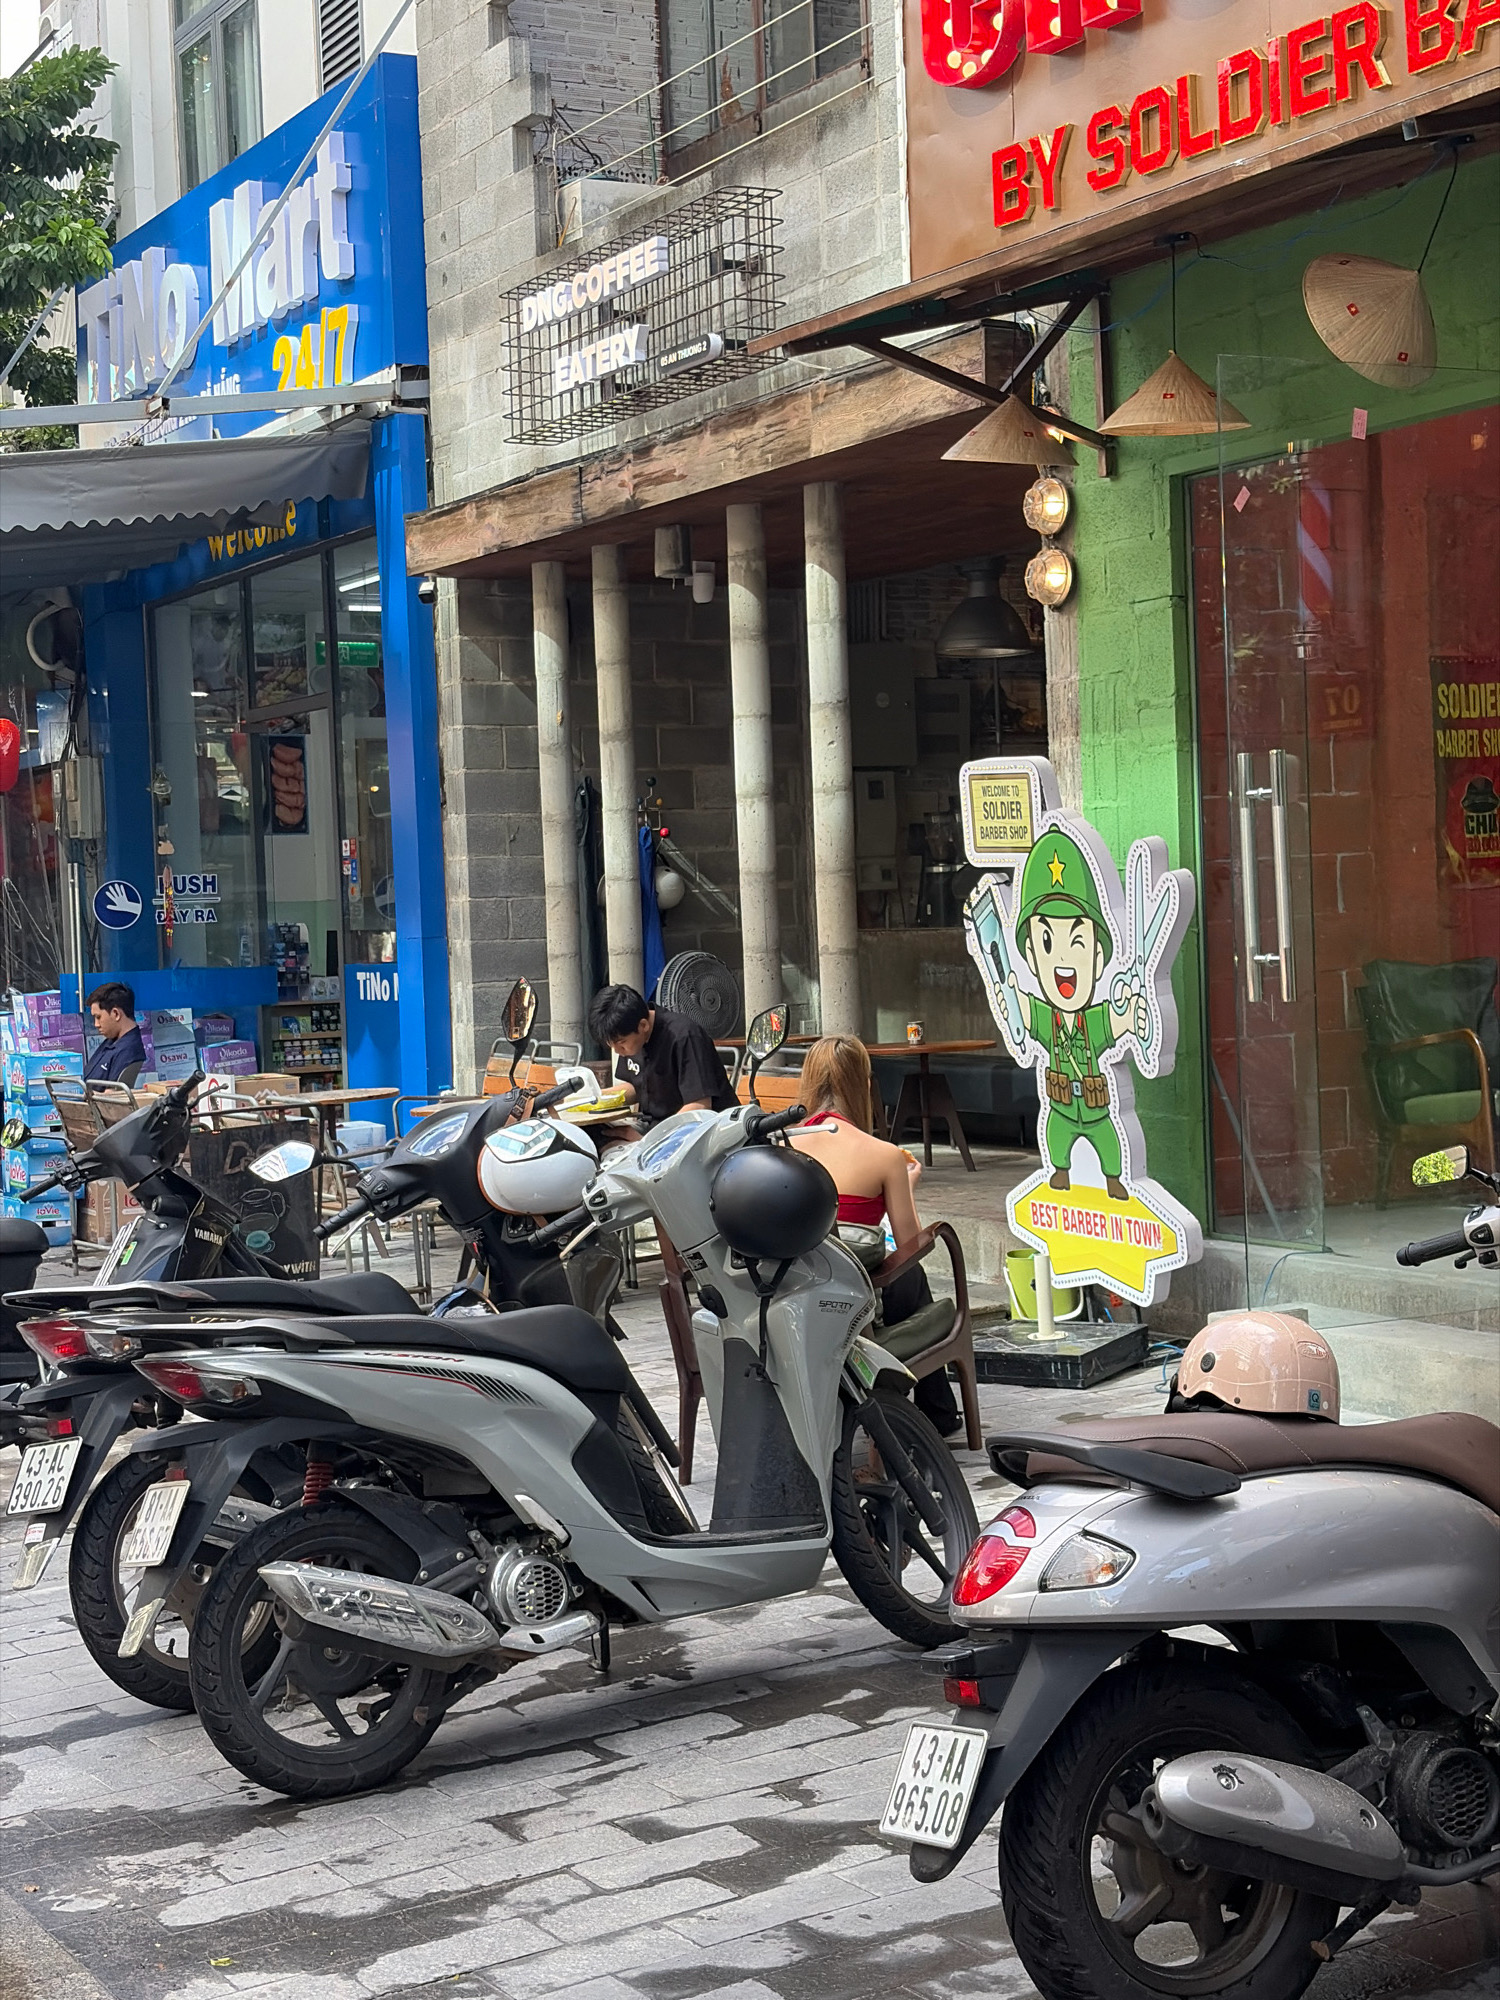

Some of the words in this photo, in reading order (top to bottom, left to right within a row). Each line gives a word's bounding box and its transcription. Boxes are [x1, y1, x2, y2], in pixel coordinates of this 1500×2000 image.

[991, 123, 1076, 229] BY
[1087, 0, 1391, 192] SOLDIER
[209, 131, 353, 346] Mart
[522, 236, 668, 333] DNG.COFFEE
[272, 303, 358, 393] 24/7
[555, 324, 649, 393] EATERY
[668, 352, 677, 364] AN
[702, 341, 707, 351] 2
[1437, 729, 1480, 757] BARBER
[981, 786, 1010, 797] WELCOME
[1012, 785, 1019, 797] TO
[983, 801, 1022, 820] SOLDIER
[980, 826, 1008, 840] BARBER
[1009, 826, 1028, 840] SHOP
[193, 908, 217, 923] RA
[356, 971, 390, 1002] TiNo
[157, 1015, 184, 1024] Osawa
[160, 1053, 187, 1063] Osawa
[194, 1227, 223, 1246] YAMAHA
[1031, 1202, 1058, 1229] BEST
[1062, 1207, 1107, 1238] BARBER
[1110, 1215, 1123, 1241] IN
[1125, 1218, 1161, 1248] TOWN
[818, 1300, 854, 1311] SPORTY
[26, 1443, 70, 1478] 43-AC
[11, 1475, 65, 1512] 390.26
[144, 1488, 179, 1524] 81-AA
[912, 1733, 970, 1785] 43-AA
[889, 1782, 964, 1838] 965.08
